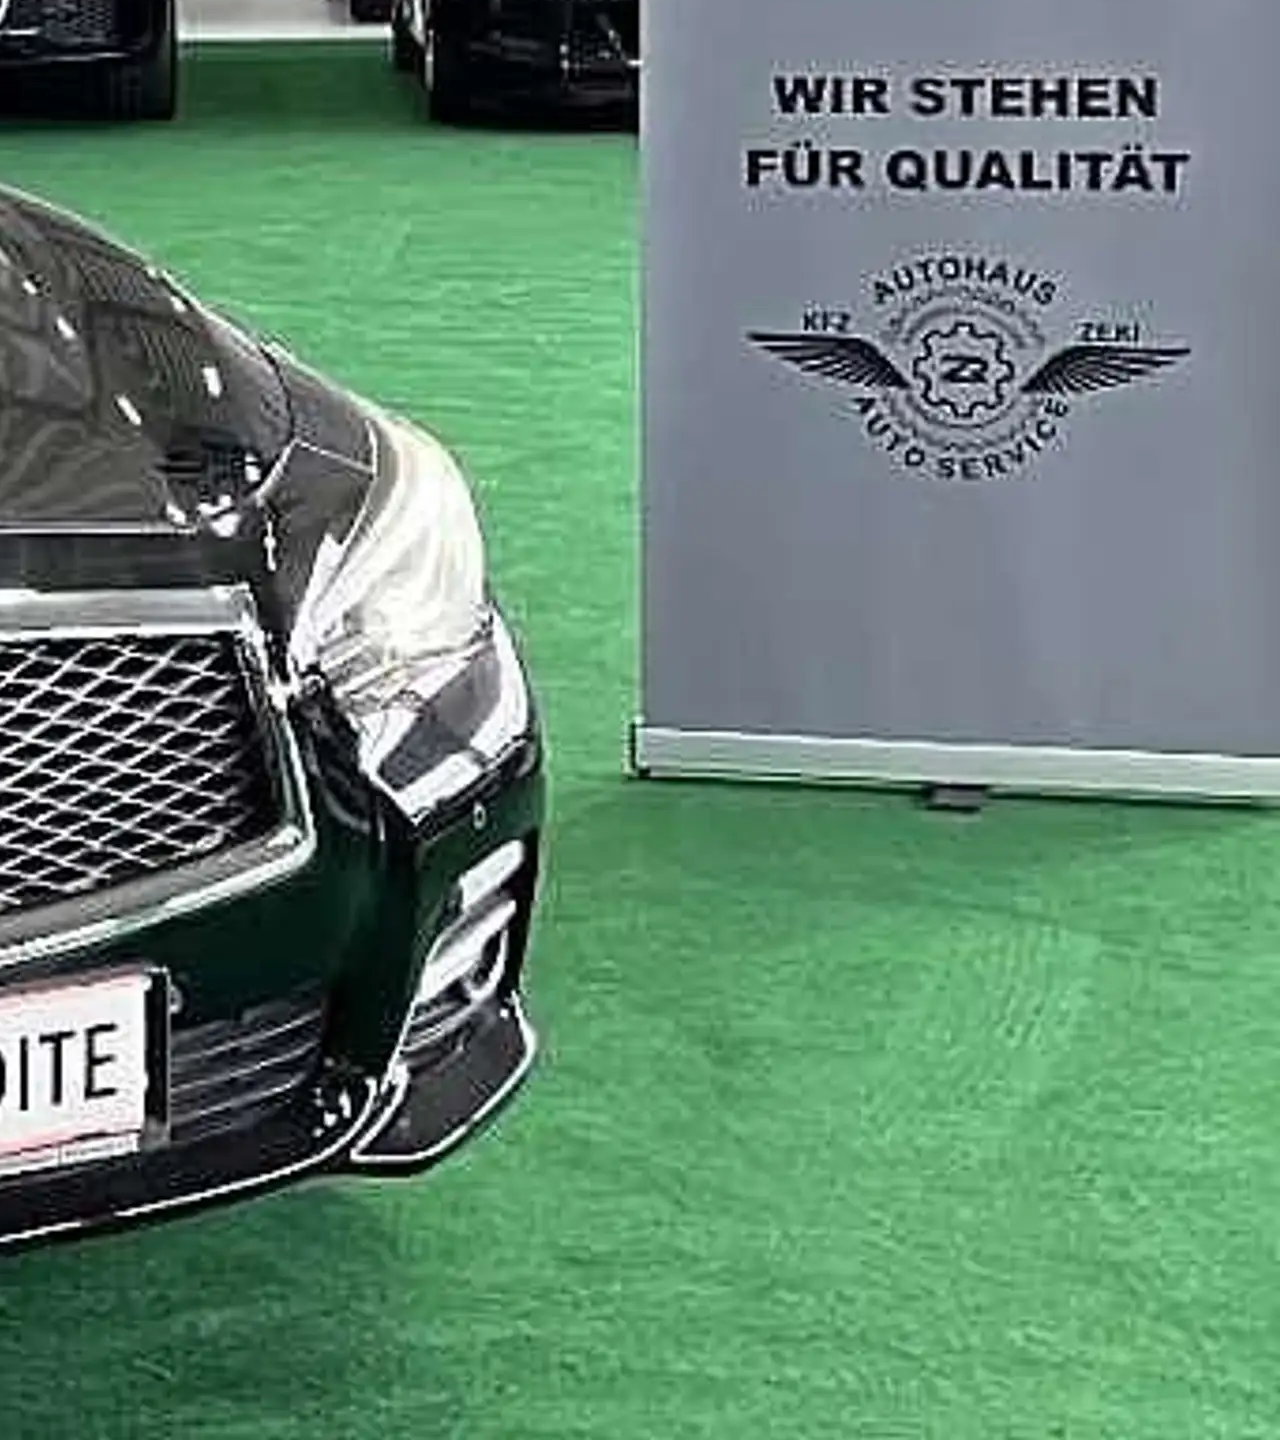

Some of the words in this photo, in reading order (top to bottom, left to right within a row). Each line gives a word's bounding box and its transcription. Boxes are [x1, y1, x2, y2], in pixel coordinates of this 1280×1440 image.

[774, 77, 889, 115] WIR
[912, 78, 1157, 119] STEHEN
[747, 140, 865, 189] FÜR
[886, 144, 1191, 193] QUALITÄT
[874, 256, 1058, 305] AUTOHAUS
[850, 396, 926, 467] AUTO
[938, 396, 1070, 480] SERVICE
